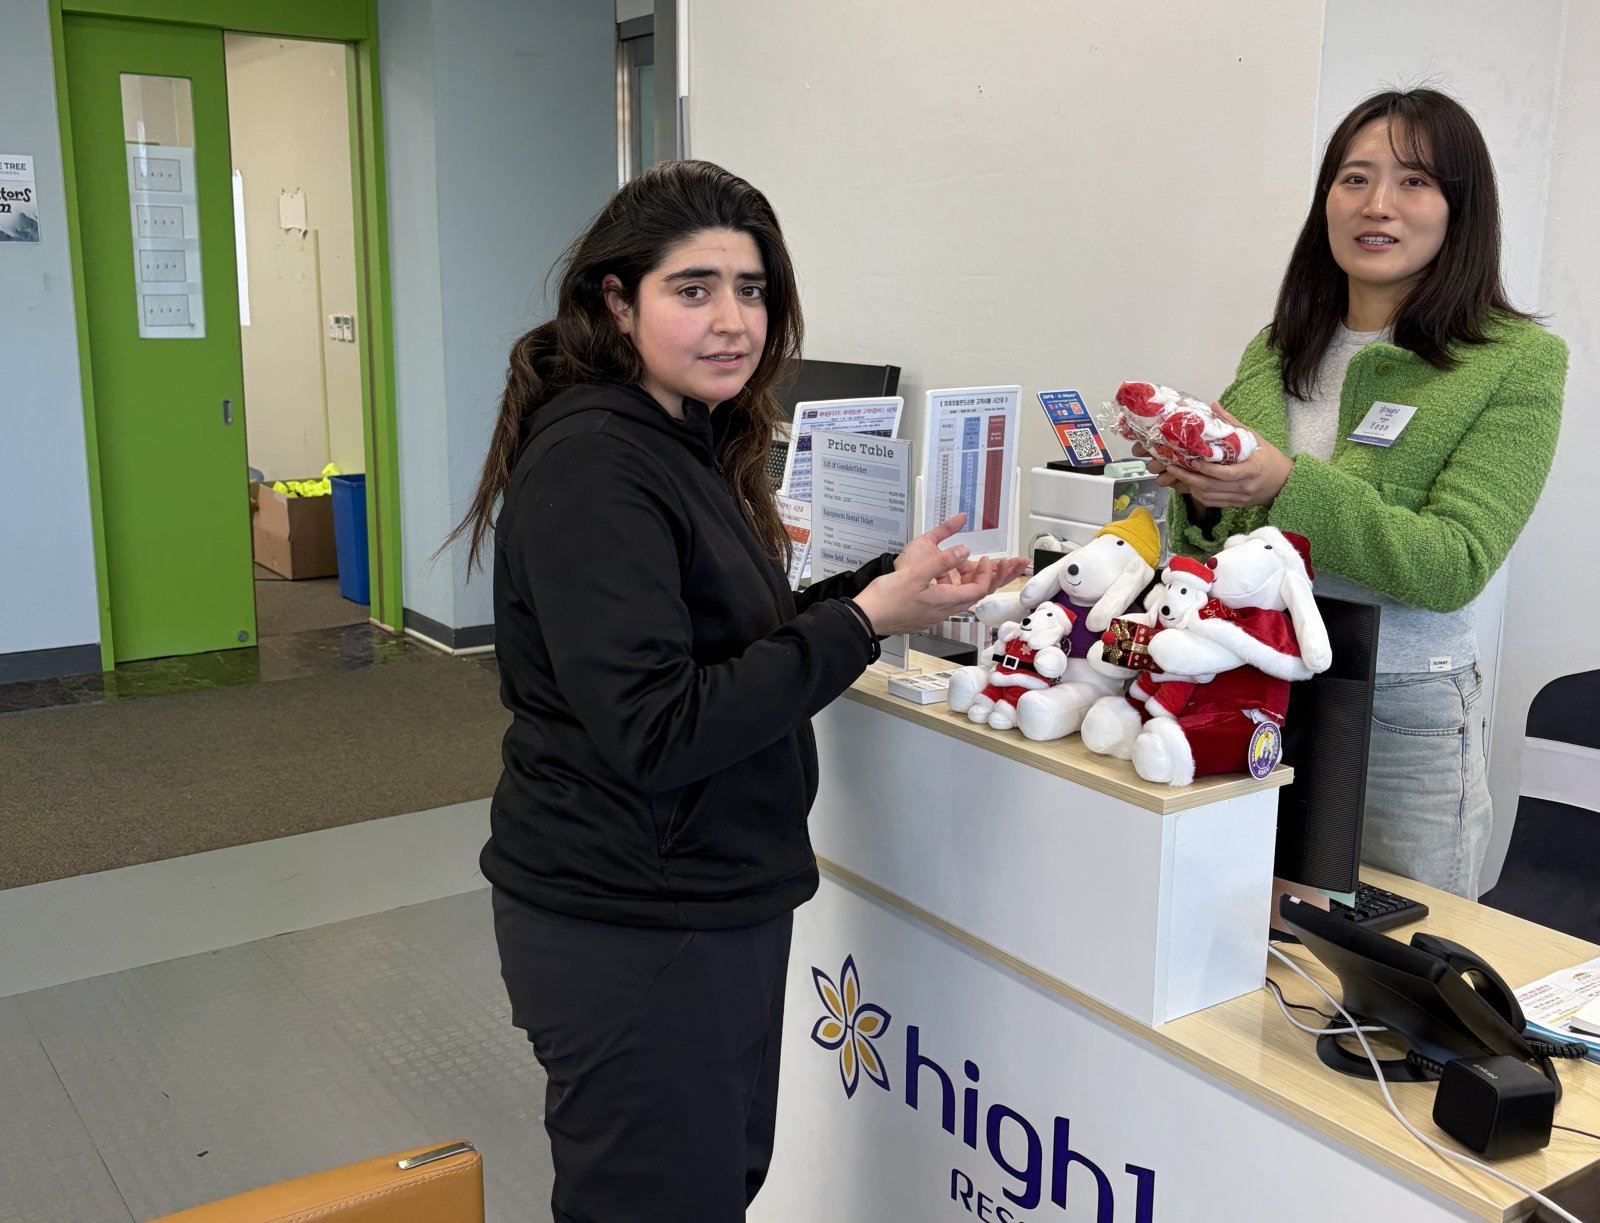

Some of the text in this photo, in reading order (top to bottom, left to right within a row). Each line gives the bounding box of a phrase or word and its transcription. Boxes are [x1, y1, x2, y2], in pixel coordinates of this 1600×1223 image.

[4, 162, 27, 171] TREE
[0, 187, 32, 203] tors
[827, 438, 894, 459] Price Table
[860, 515, 874, 526] Ticket
